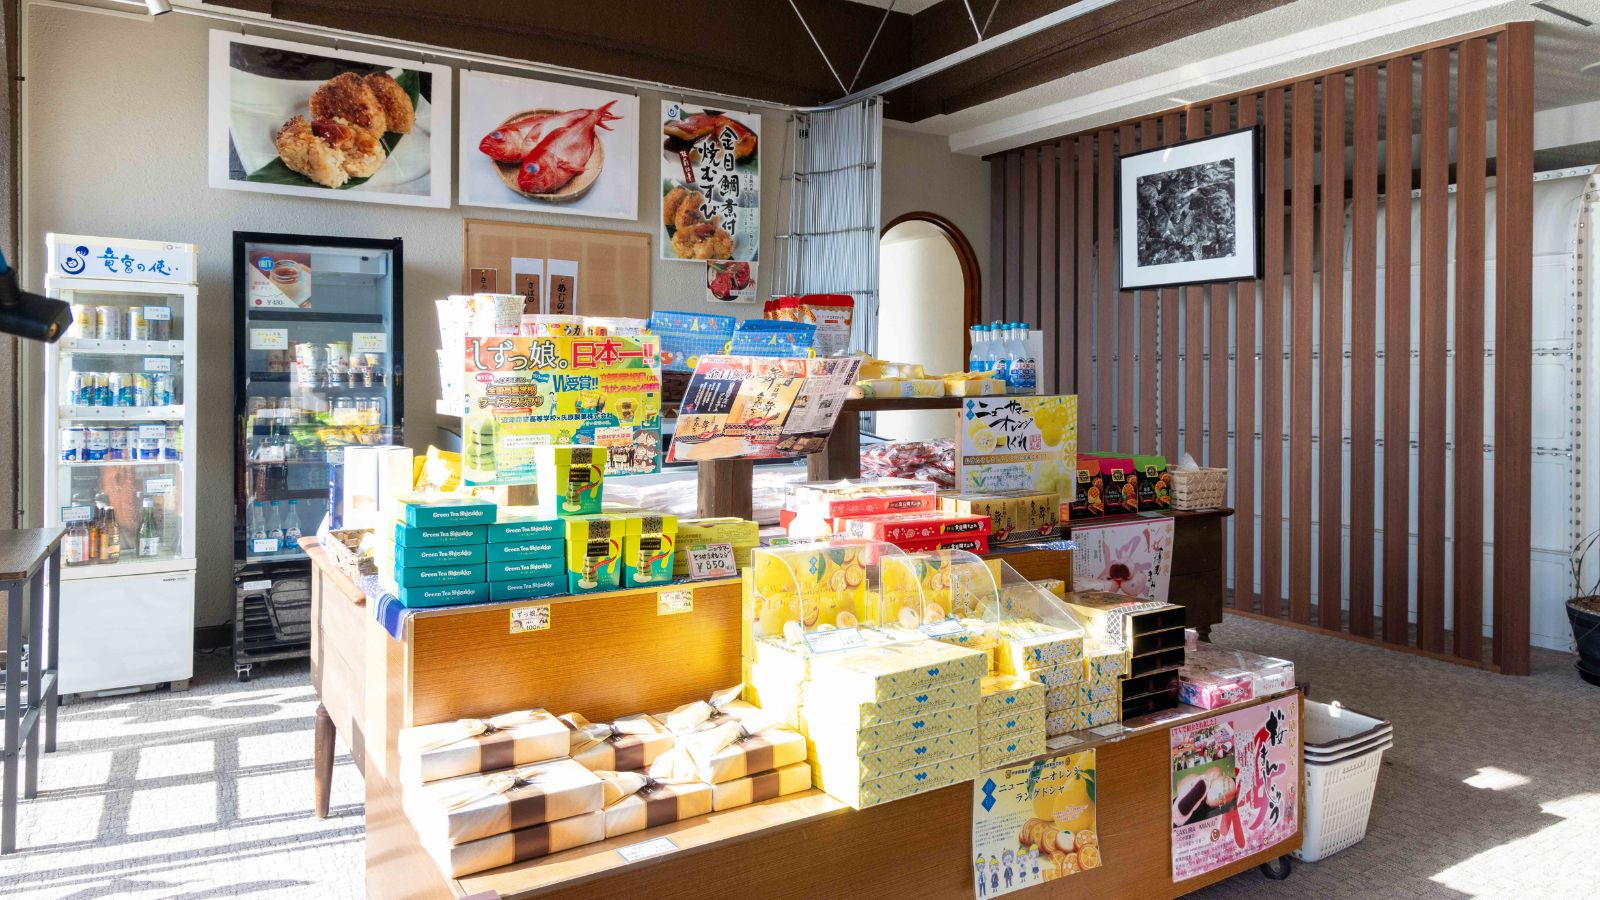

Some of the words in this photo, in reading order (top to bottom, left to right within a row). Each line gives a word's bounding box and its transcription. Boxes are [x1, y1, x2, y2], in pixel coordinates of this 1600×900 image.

[698, 141, 721, 221] 焼むすび
[719, 126, 740, 236] 金目鯛煮付
[96, 246, 179, 276] 竜宮の使い
[556, 283, 566, 314] あじの
[975, 399, 1030, 418] ニューサマー
[988, 415, 1034, 432] オレンジ
[1007, 433, 1028, 452] しぐれ
[998, 765, 1081, 793] ニューサマーオレンジ
